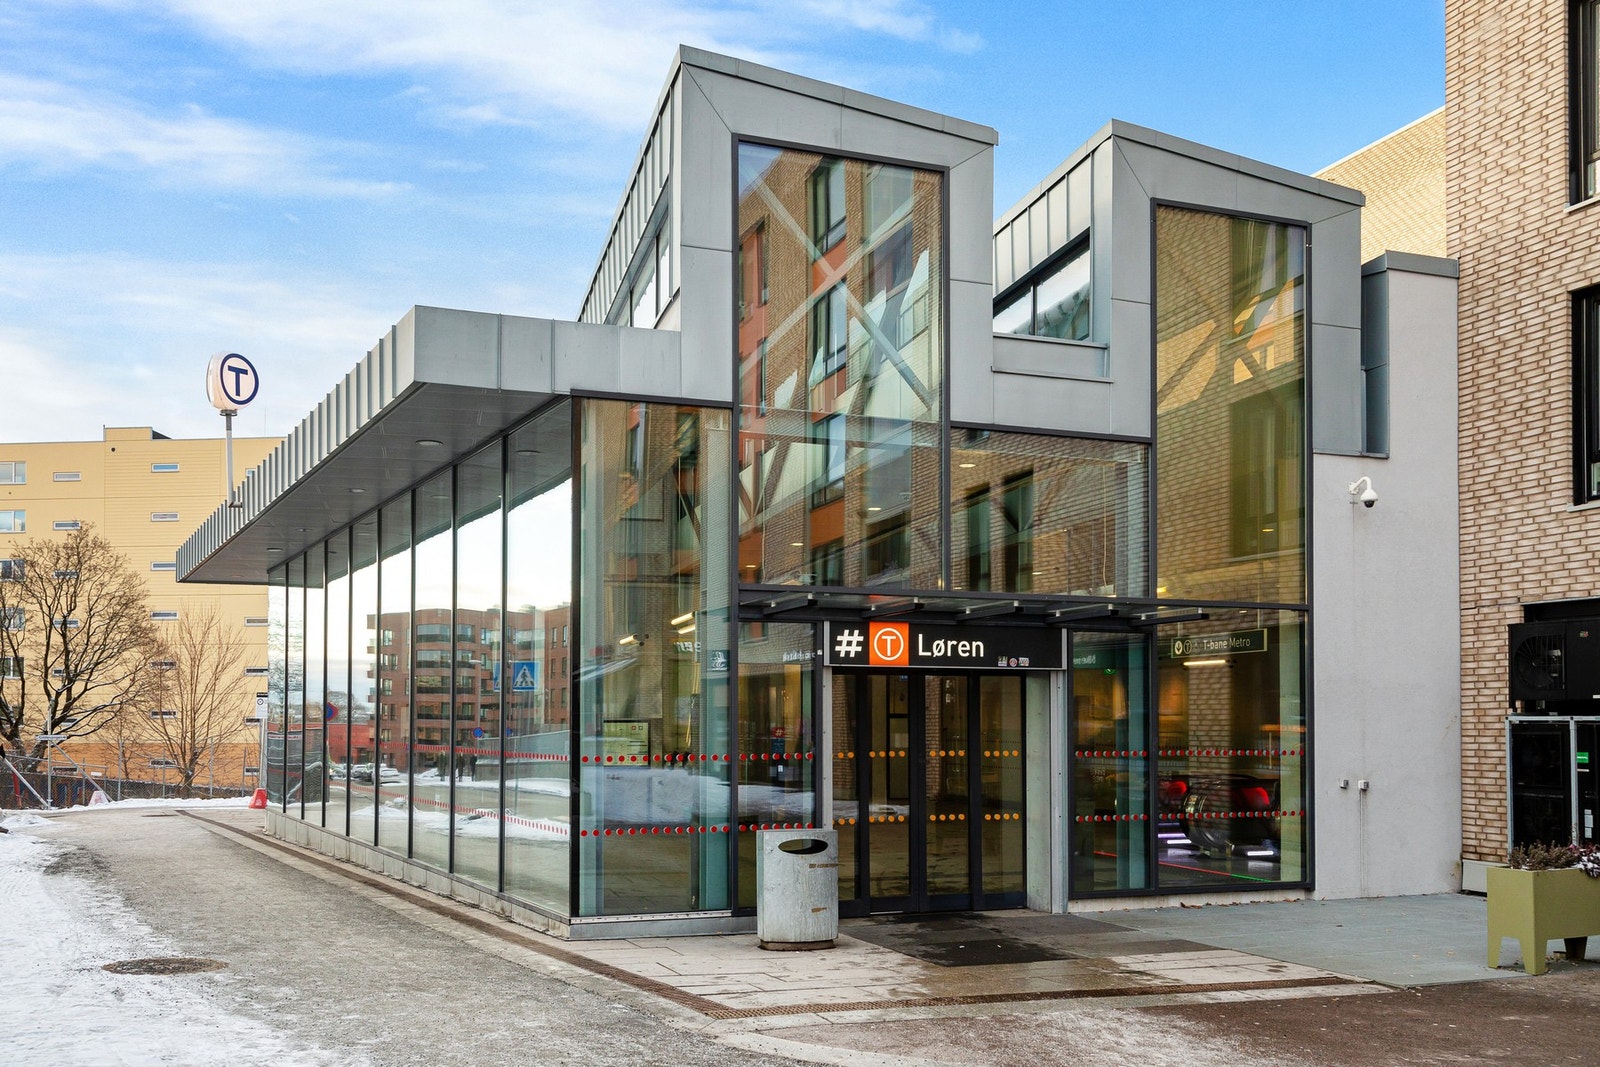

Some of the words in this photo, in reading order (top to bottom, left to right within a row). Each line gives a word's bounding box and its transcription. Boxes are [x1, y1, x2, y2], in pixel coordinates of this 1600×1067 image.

[227, 365, 249, 397] T
[917, 633, 984, 658] Løren
[1203, 639, 1228, 650] T-bane
[1229, 637, 1251, 648] Metro
